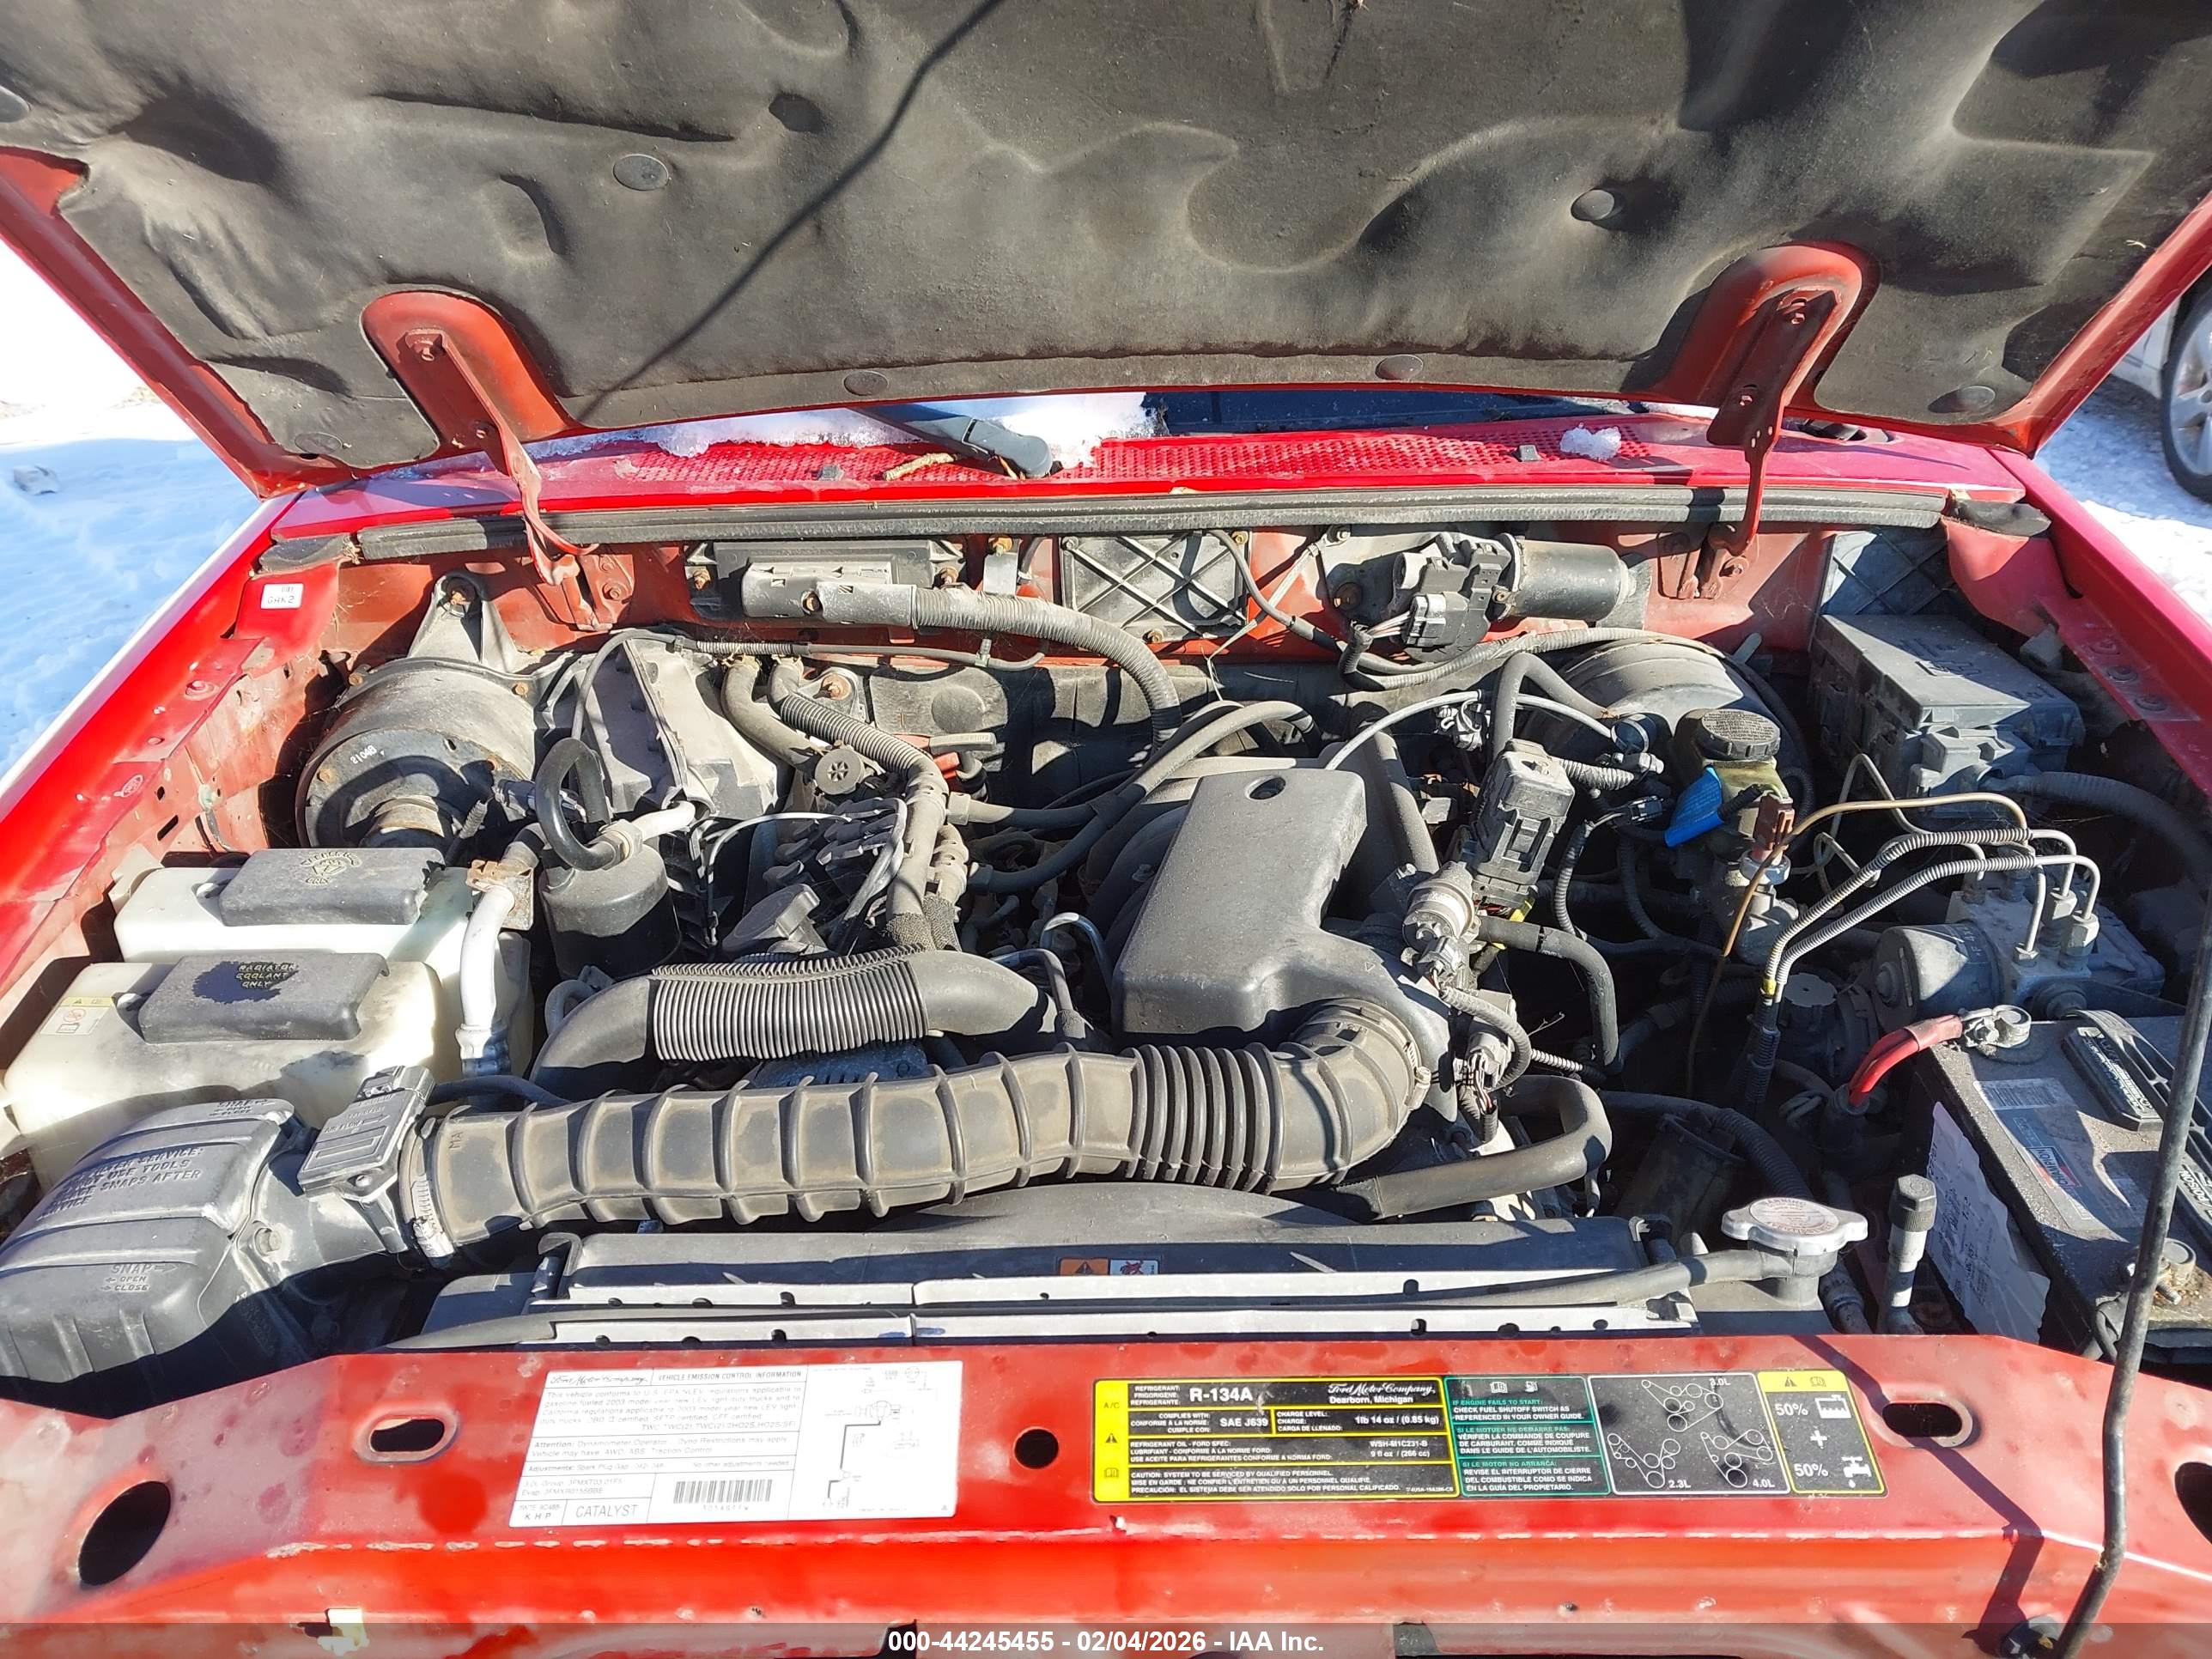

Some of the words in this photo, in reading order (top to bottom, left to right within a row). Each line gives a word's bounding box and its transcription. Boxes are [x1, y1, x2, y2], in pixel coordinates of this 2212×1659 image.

[238, 963, 298, 973] RADIATOR
[235, 972, 289, 981] COOLANT
[106, 1167, 137, 1181] USE
[142, 1159, 191, 1173] TOOLS
[2036, 1148, 2069, 1187] CHAMPION
[100, 1175, 151, 1192] SNAPS
[152, 1169, 202, 1182] AFTER
[2179, 1169, 2209, 1202] POISON
[112, 1263, 155, 1274] SNAP
[1189, 1387, 1252, 1401] R-134A
[1328, 1382, 1352, 1394] Ford
[1351, 1382, 1384, 1395] Motor
[1382, 1382, 1436, 1396] Company
[1775, 1402, 1808, 1417] 50%
[1219, 1418, 1242, 1426] SAE
[1243, 1418, 1268, 1426] J639
[1401, 1415, 1423, 1424] (0.85
[1424, 1415, 1439, 1424] kg)
[1794, 1463, 1829, 1477] 50%
[1668, 1480, 1692, 1489] 2.3L
[1753, 1478, 1776, 1488] 4.0L
[574, 1504, 639, 1517] CATALYST
